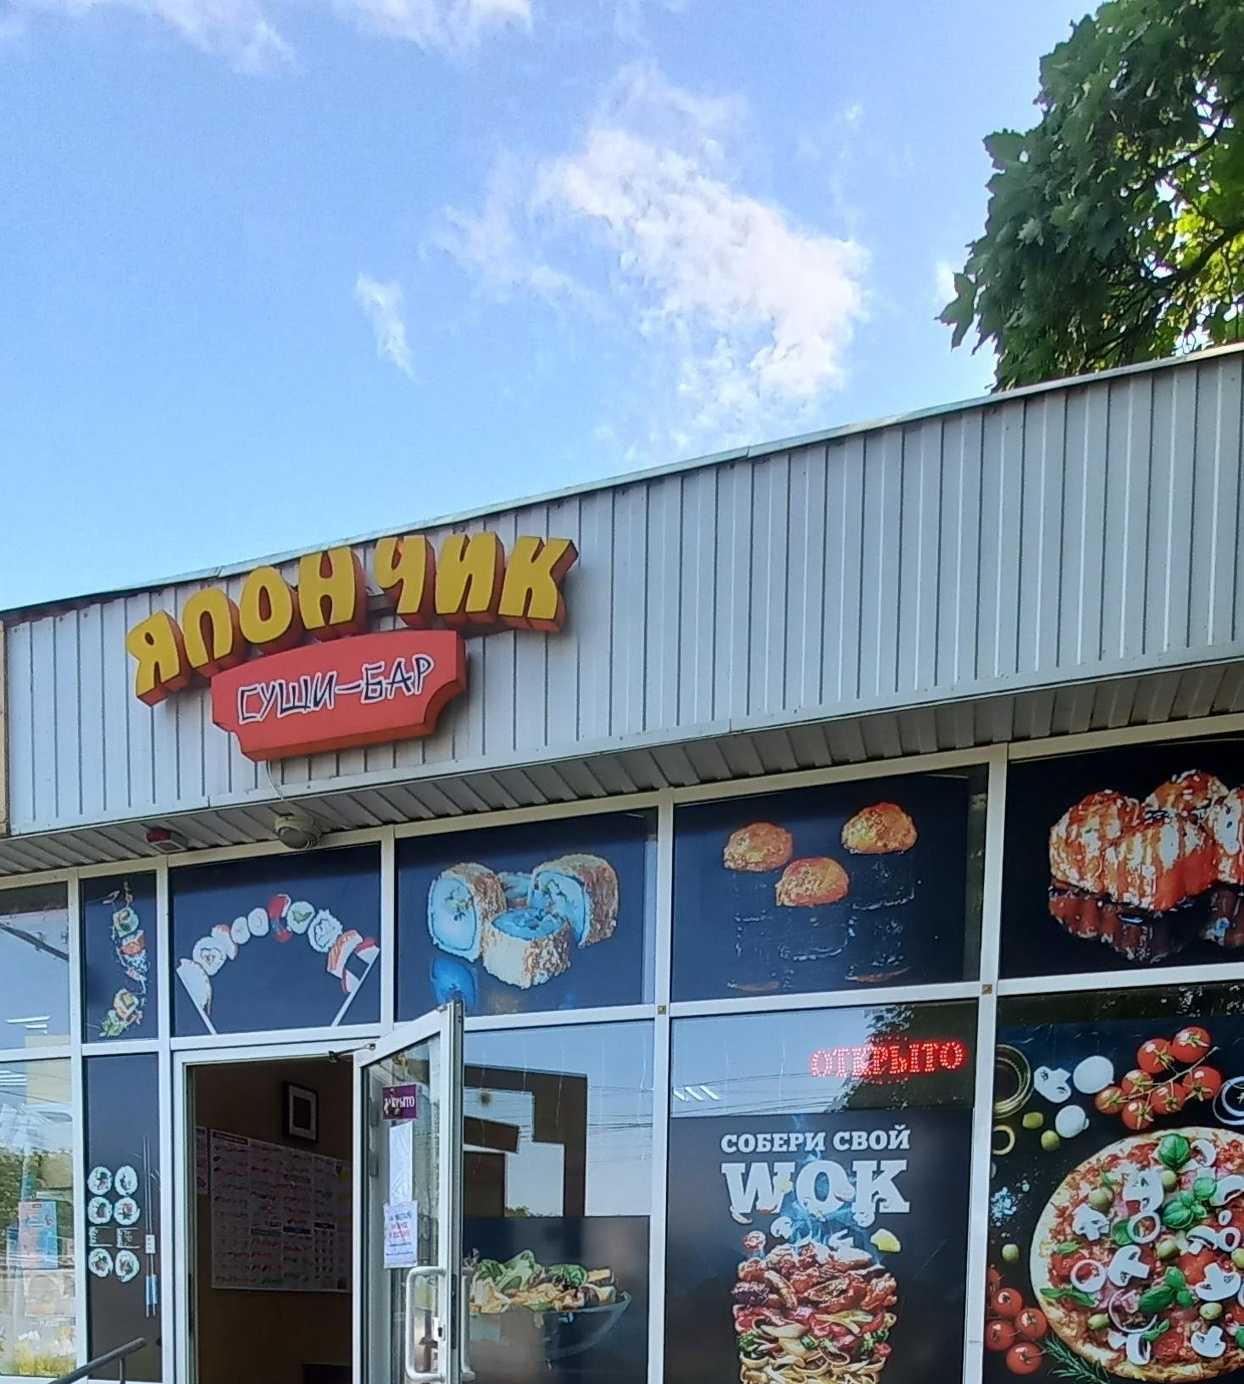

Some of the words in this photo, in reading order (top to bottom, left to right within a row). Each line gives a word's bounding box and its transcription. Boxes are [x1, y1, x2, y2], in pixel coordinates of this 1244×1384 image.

[126, 531, 578, 706] ЯПОНЧИК
[237, 653, 435, 726] СУШИ-БАР
[811, 1040, 965, 1079] ОТКРЫТО
[720, 1132, 825, 1153] СОБЕРИ
[832, 1125, 911, 1151] СВОЙ
[721, 1159, 911, 1214] WOK
